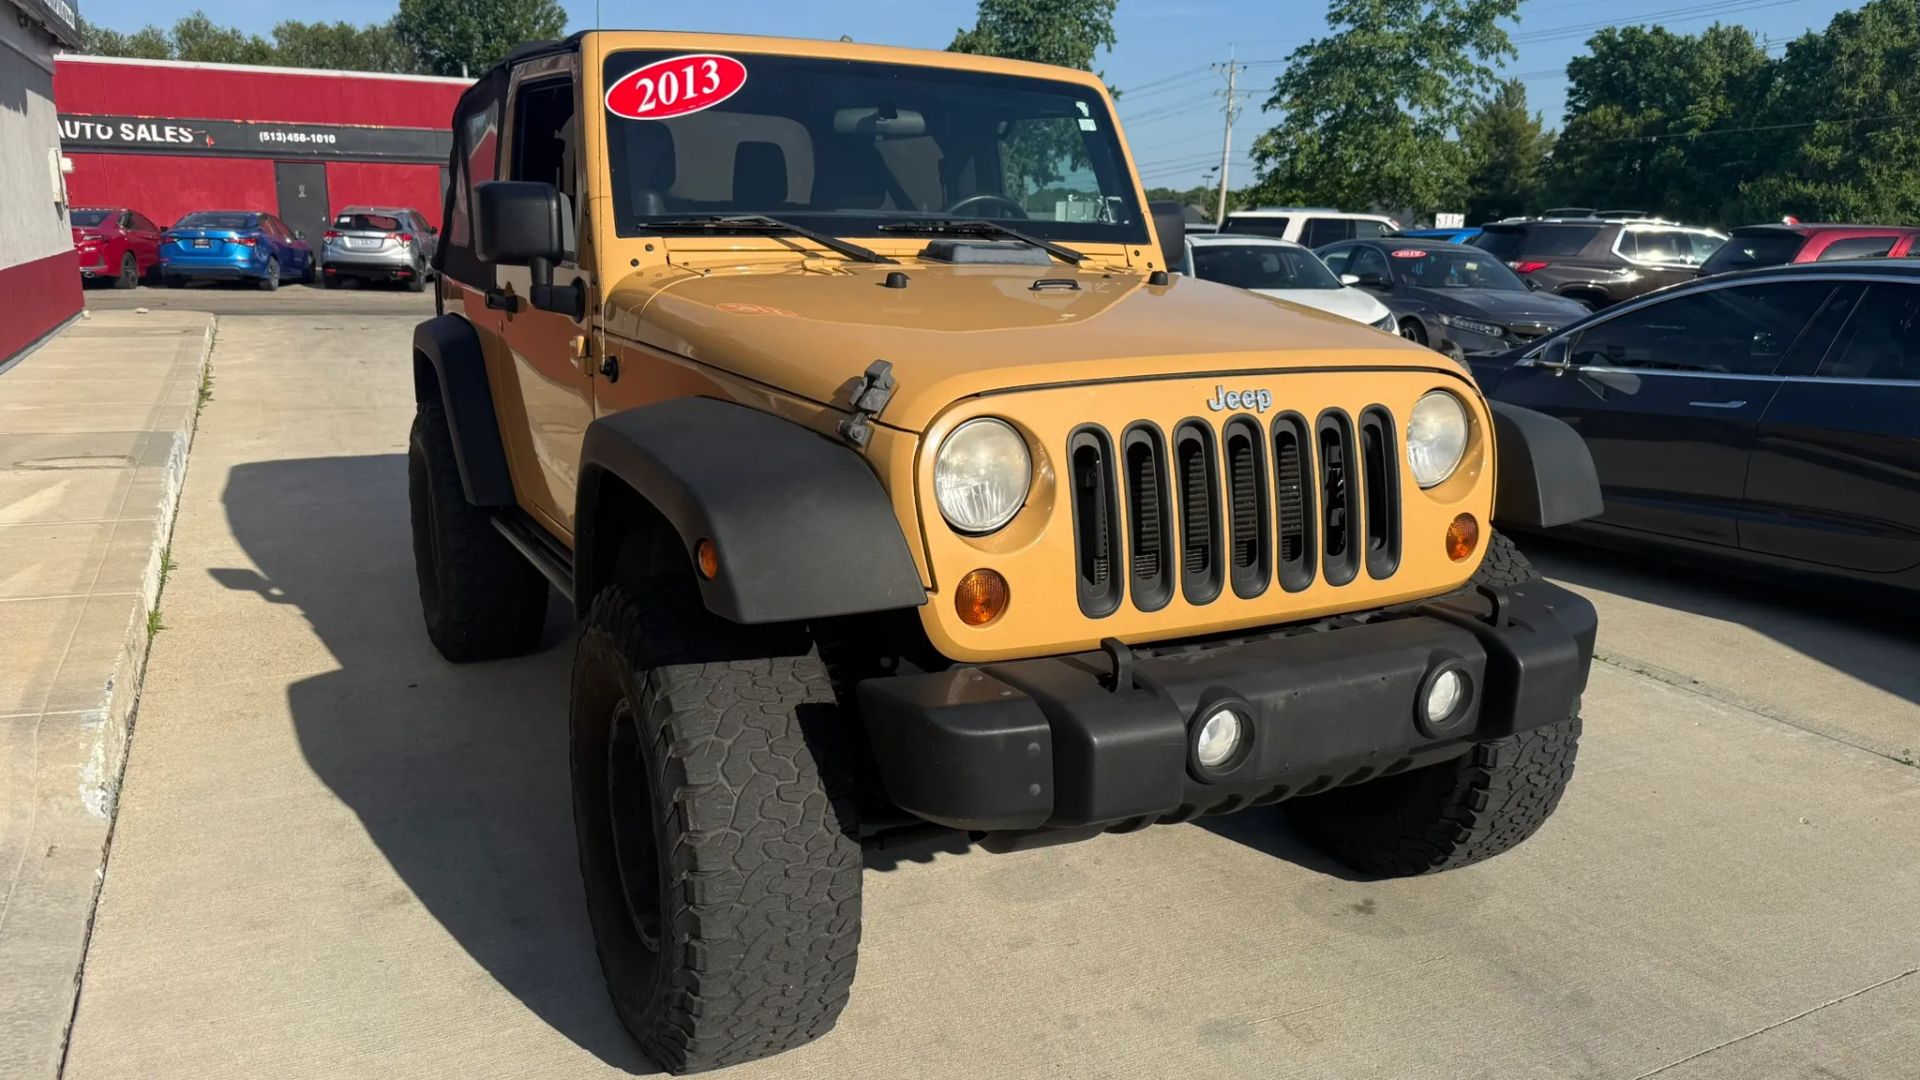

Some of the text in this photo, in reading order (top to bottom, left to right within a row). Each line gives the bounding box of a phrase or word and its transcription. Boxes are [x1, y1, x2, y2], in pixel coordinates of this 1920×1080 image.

[635, 59, 720, 113] 2013
[120, 123, 194, 143] SALES
[1206, 385, 1272, 413] Jeep
